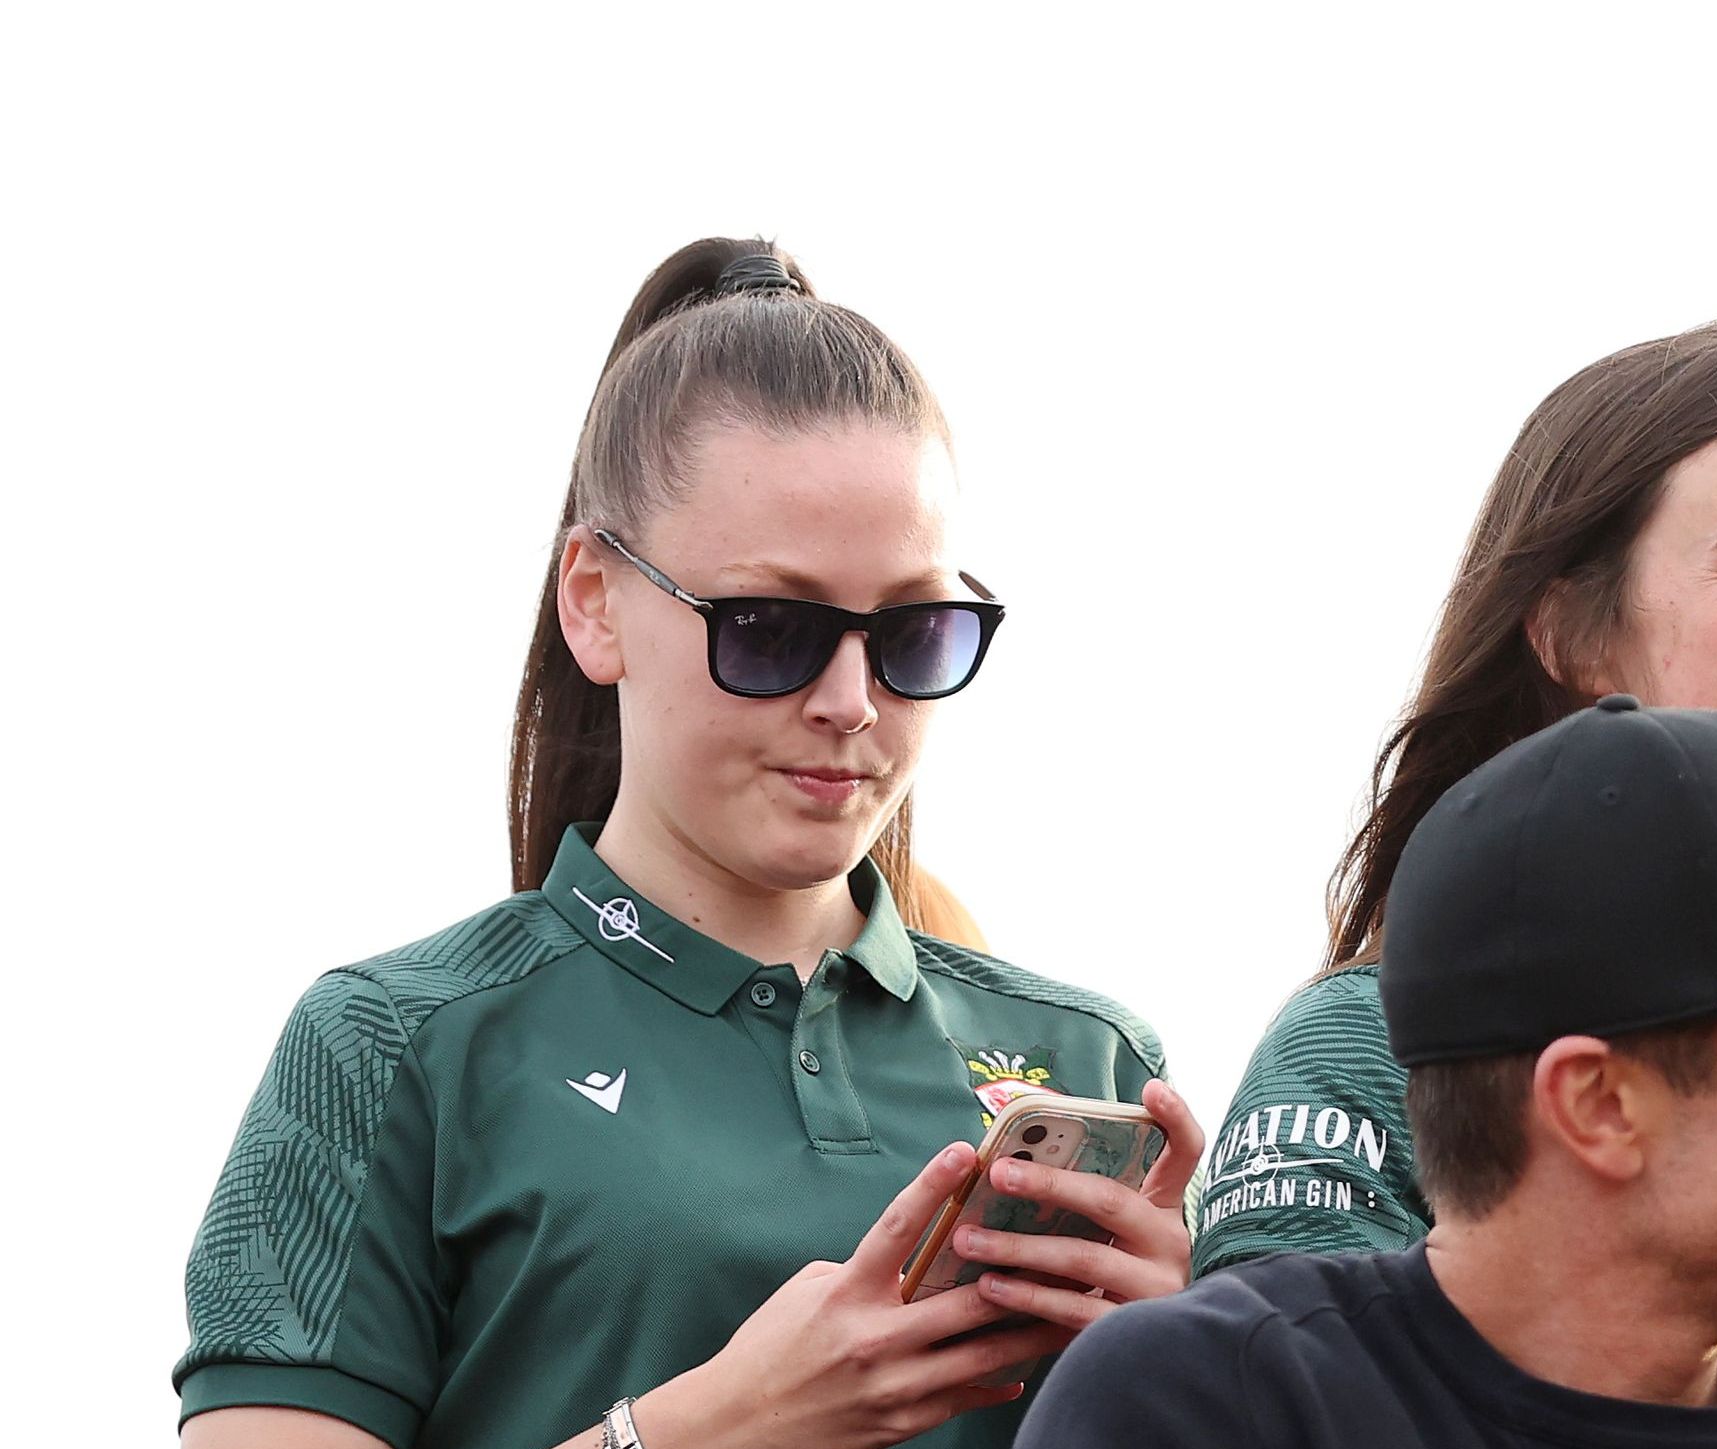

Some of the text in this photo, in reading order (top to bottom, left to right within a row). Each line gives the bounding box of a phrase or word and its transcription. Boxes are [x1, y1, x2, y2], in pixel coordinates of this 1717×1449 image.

[1201, 1104, 1388, 1204] AVIATION
[1203, 1179, 1352, 1234] AMERICAN GIN
